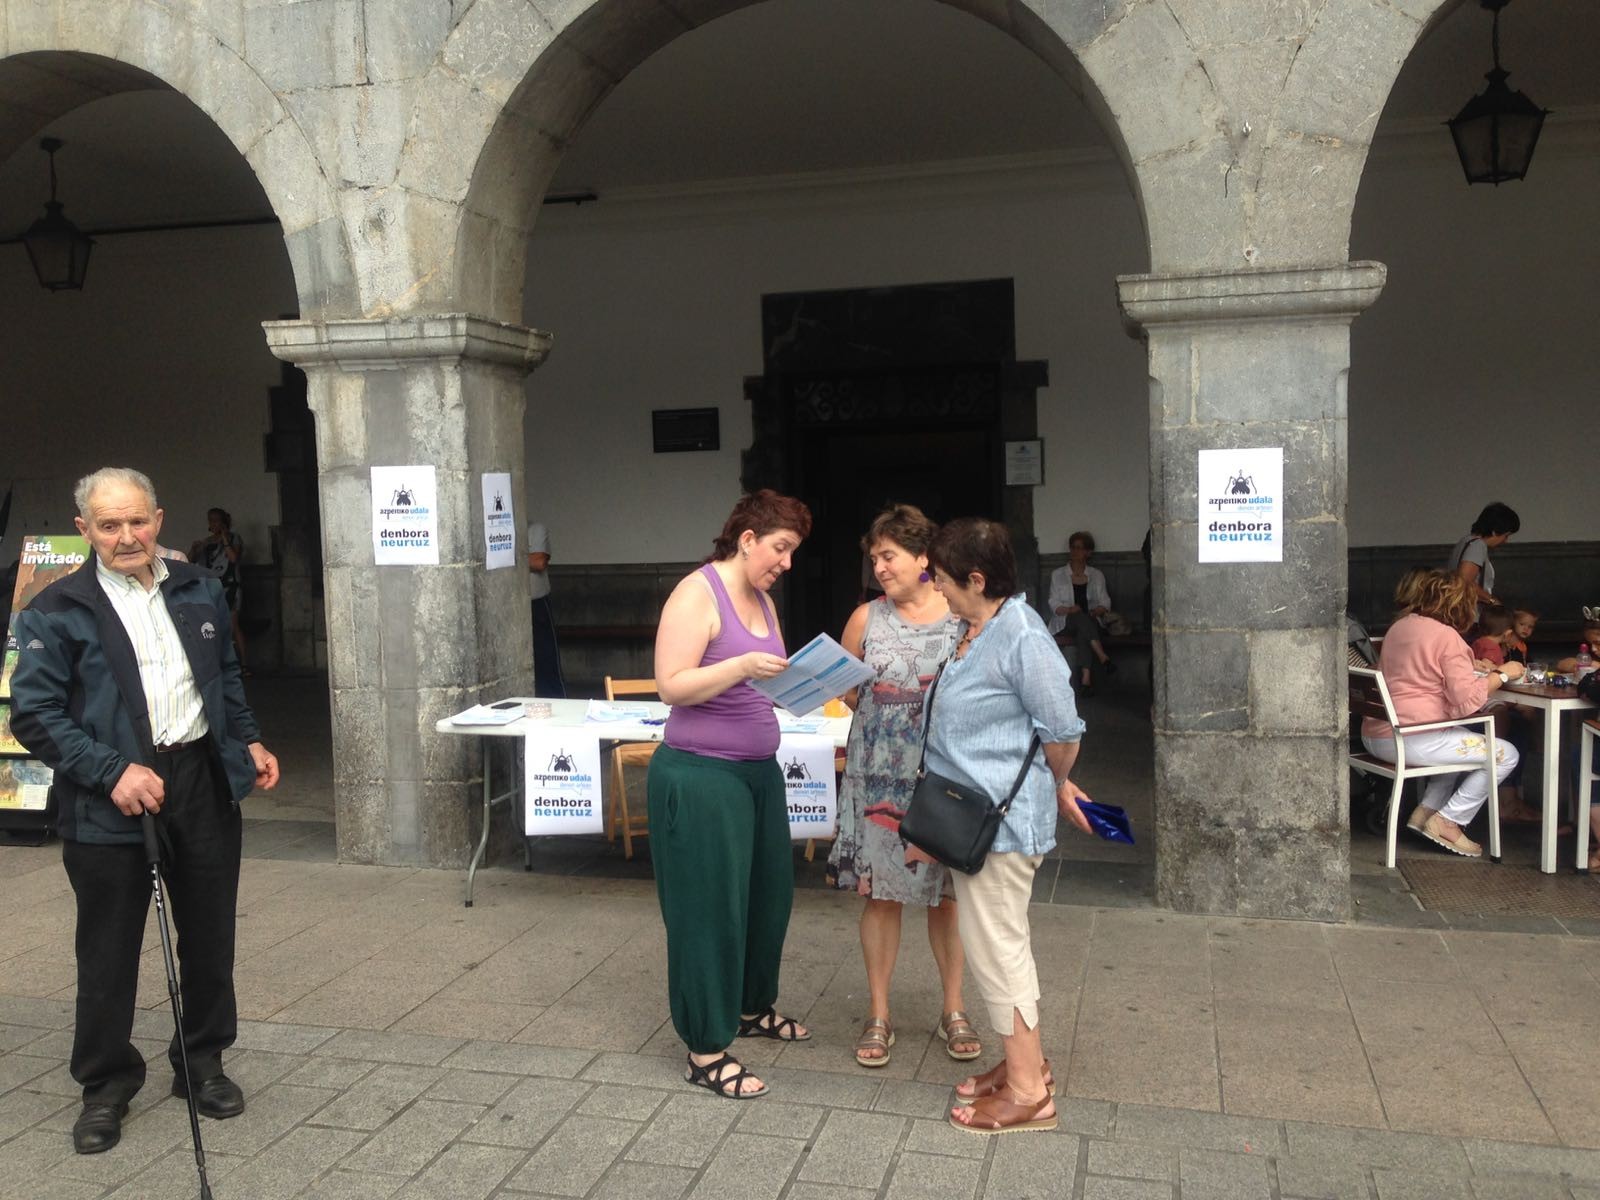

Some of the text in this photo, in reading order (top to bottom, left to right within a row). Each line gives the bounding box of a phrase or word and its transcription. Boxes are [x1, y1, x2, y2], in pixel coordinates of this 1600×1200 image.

[1248, 496, 1273, 504] udala
[1209, 521, 1272, 532] denbora
[380, 528, 429, 538] denbora
[1209, 533, 1272, 541] neurtuz
[25, 541, 52, 552] Está
[22, 552, 85, 565] invitado
[570, 774, 592, 782] udala
[804, 781, 827, 789] udala
[534, 796, 592, 807] denbora
[535, 808, 592, 817] neurtuz
[787, 803, 827, 814] nbora
[789, 815, 828, 823] urtuz
